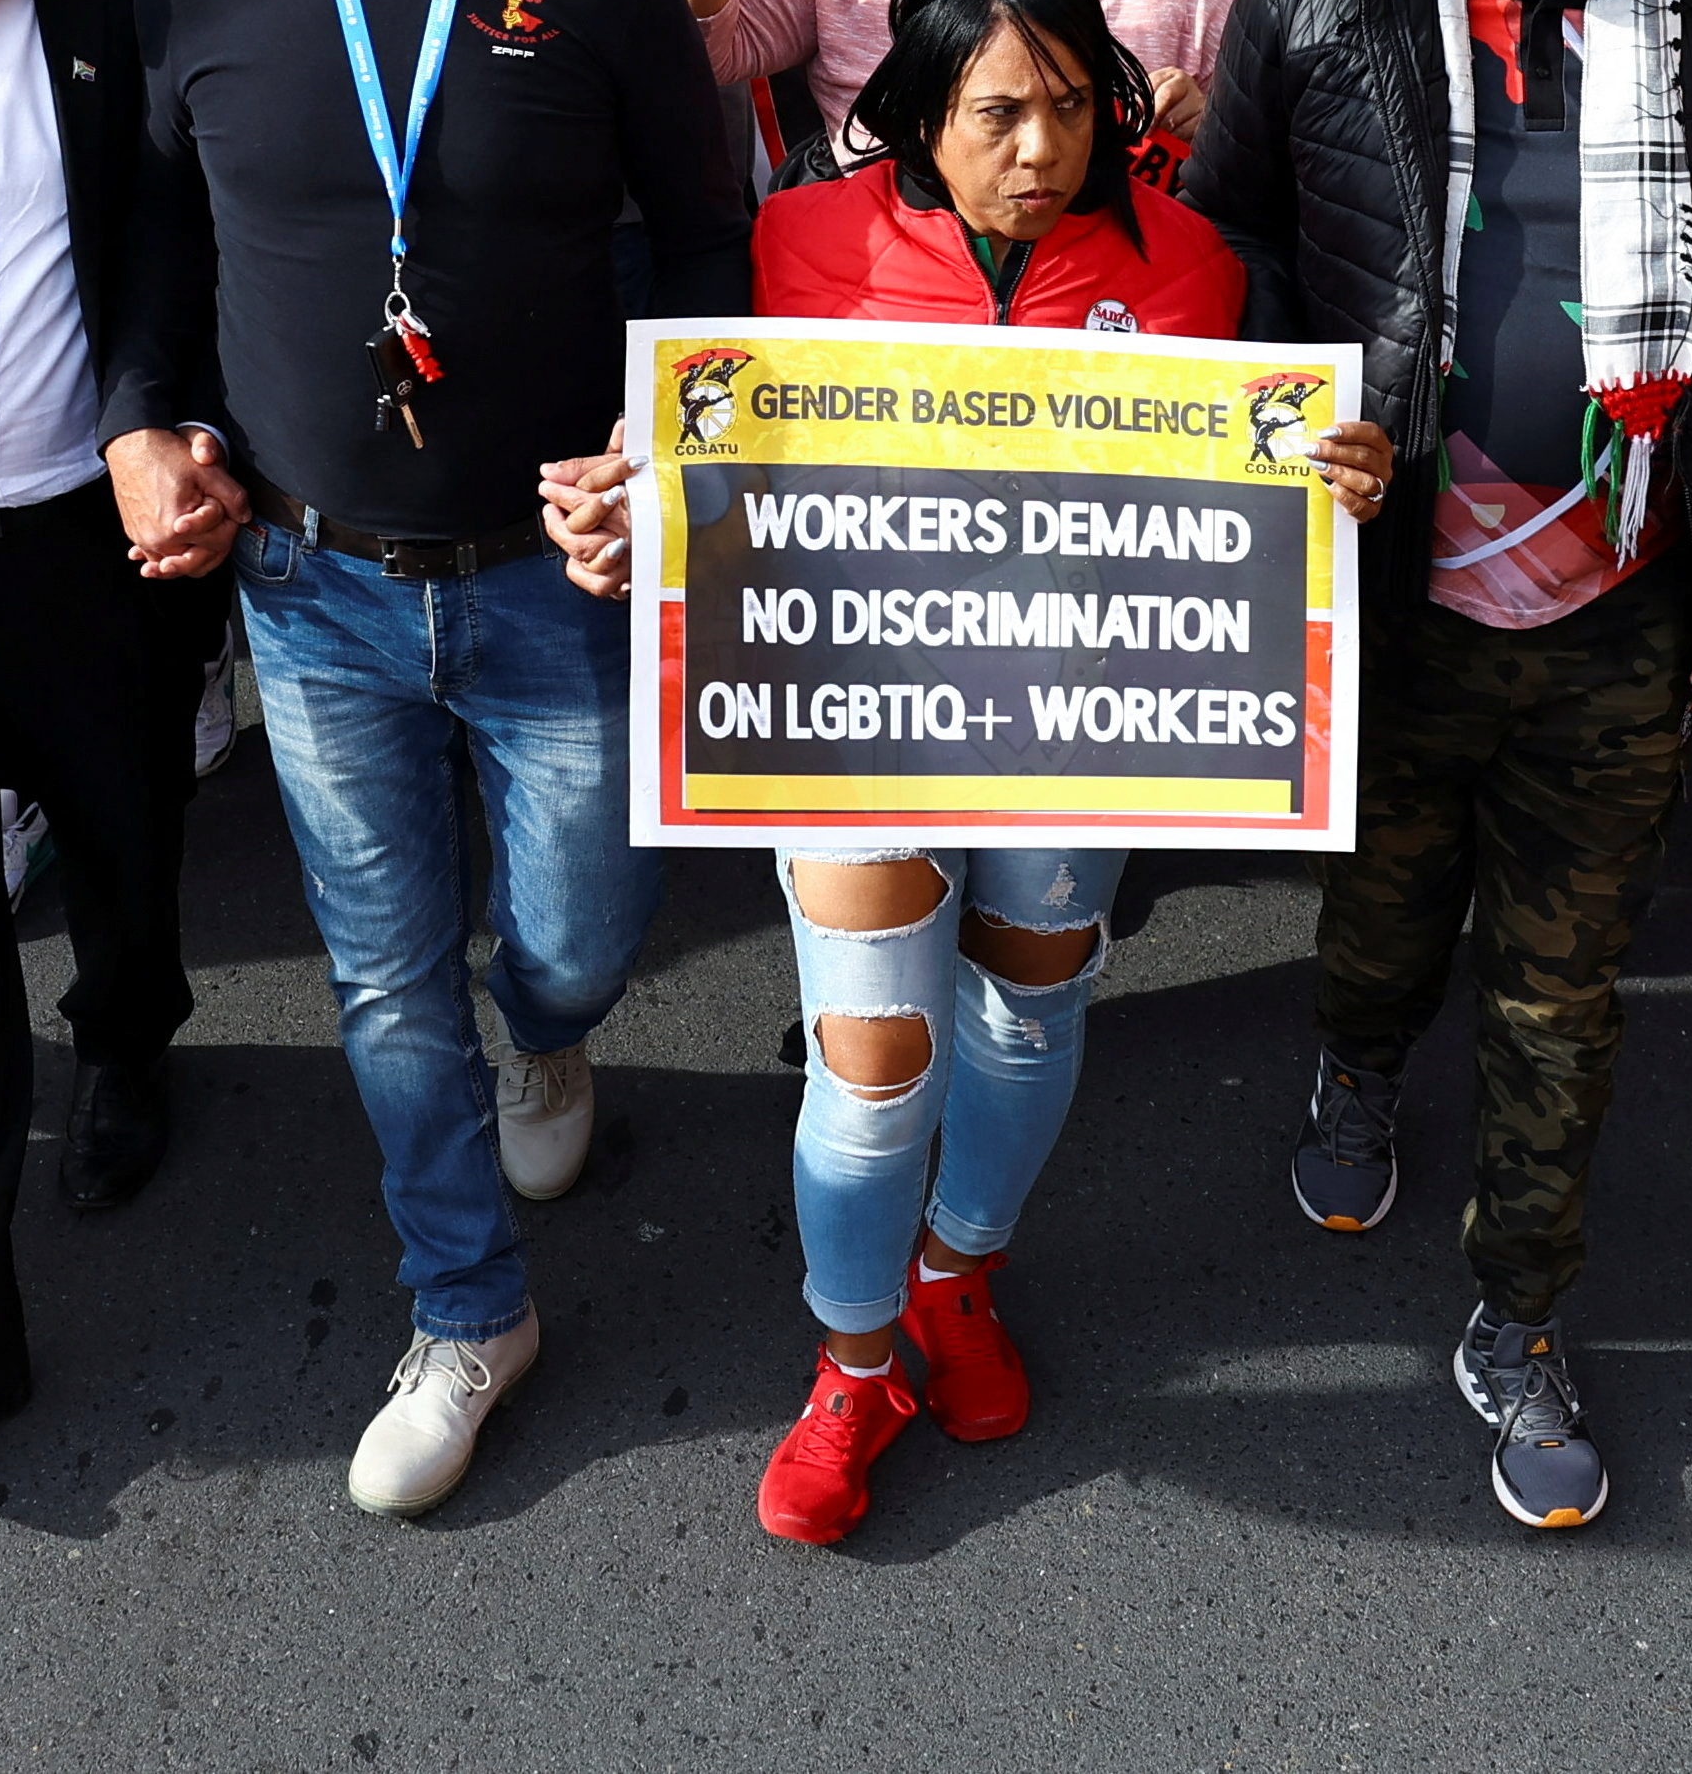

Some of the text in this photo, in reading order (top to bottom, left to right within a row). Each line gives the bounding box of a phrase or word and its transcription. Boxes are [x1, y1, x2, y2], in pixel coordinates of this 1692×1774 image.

[465, 12, 562, 45] JUSTICE FOR ALL
[1091, 305, 1136, 328] SADTU
[749, 382, 1229, 439] GENDER BASED VIOLENCE
[674, 443, 740, 457] COSATU
[1243, 462, 1311, 477] COSATU
[743, 491, 1252, 564] WORKERS DEMAND
[742, 587, 1251, 653] NO DISCRIMINATION
[698, 681, 1298, 746] ON LGBTIQ+ WORKERS
